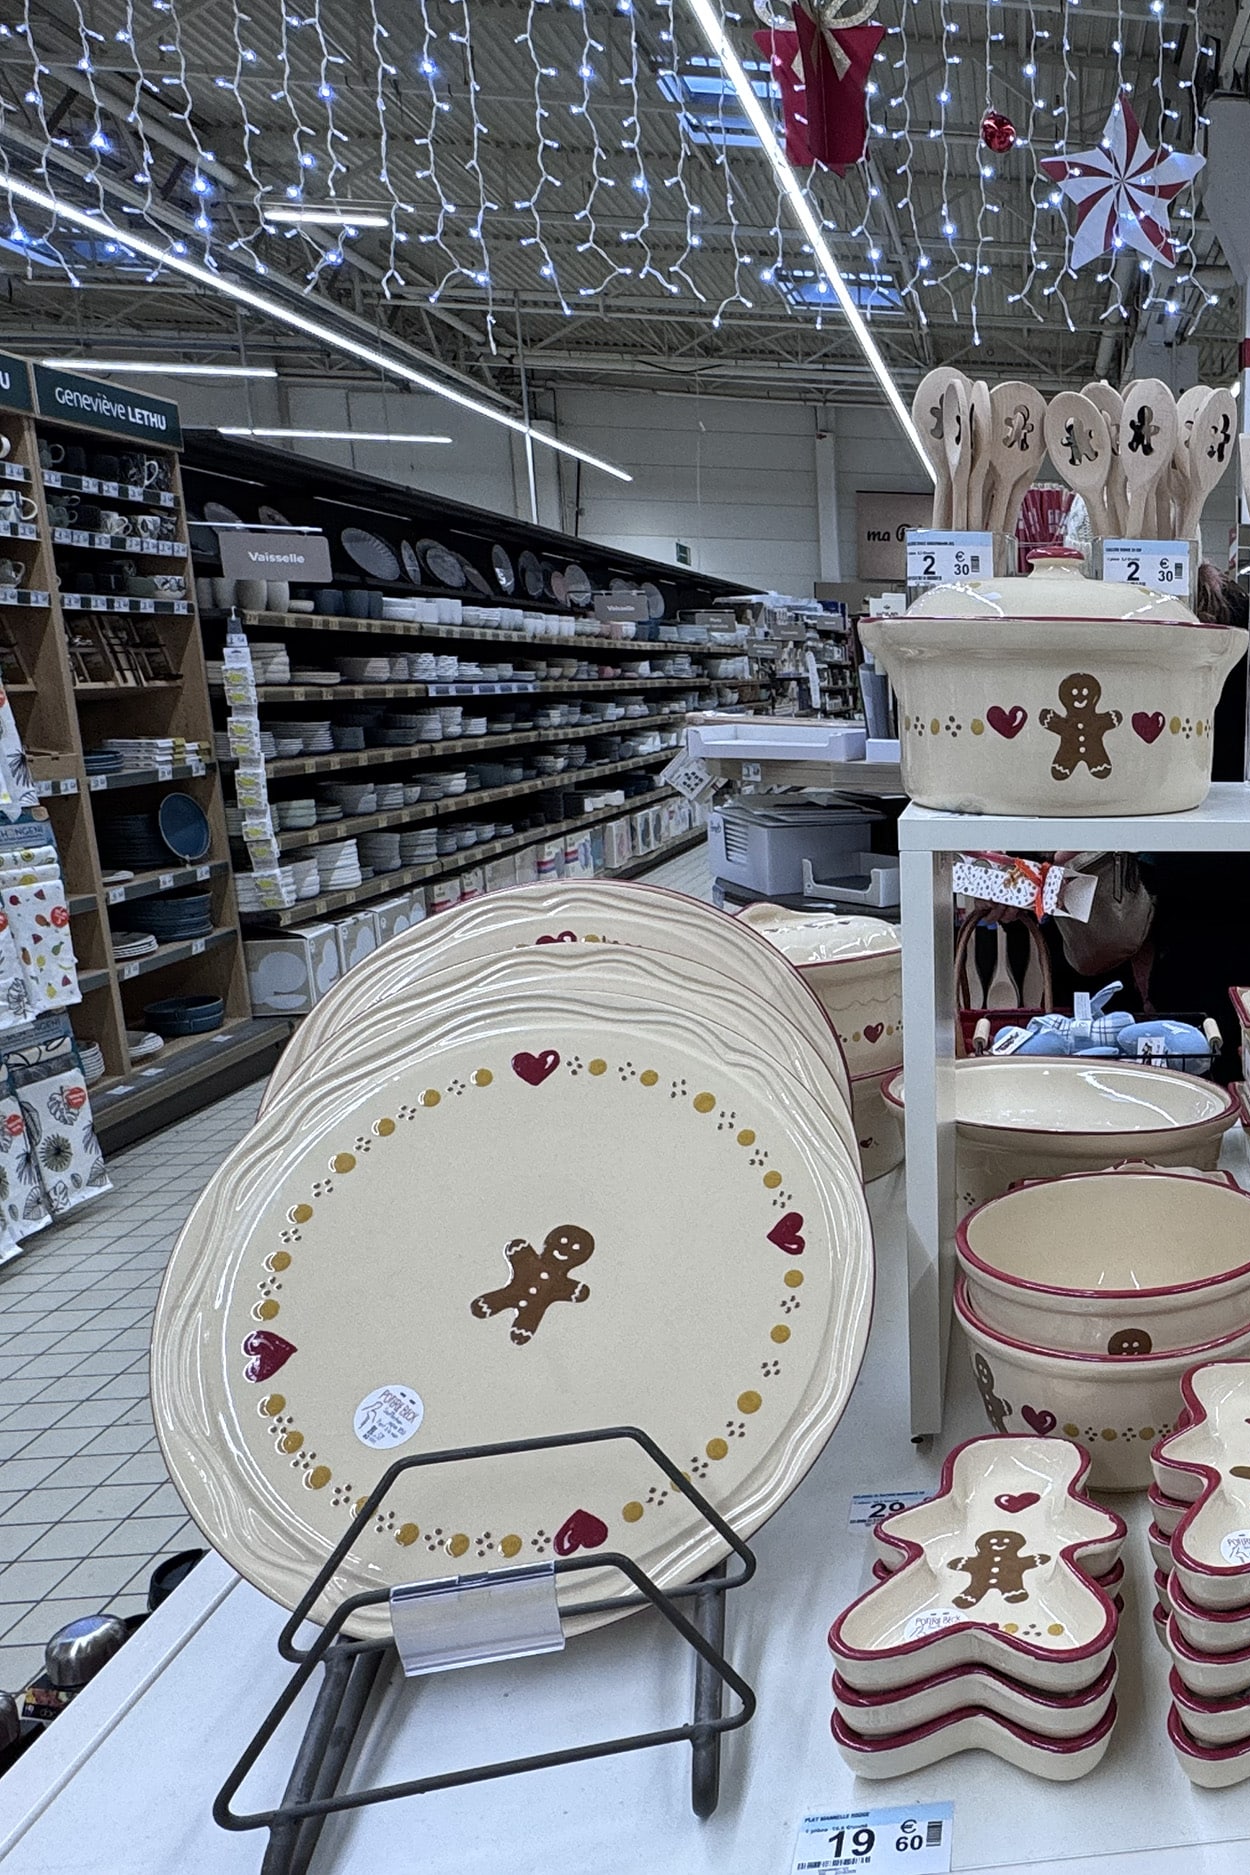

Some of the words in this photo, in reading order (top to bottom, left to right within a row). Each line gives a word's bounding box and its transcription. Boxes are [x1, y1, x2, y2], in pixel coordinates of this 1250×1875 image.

[55, 387, 126, 421] Geneviève
[128, 406, 167, 431] LETHU
[867, 530, 890, 542] ma
[248, 551, 305, 565] Vaisselle
[955, 551, 966, 562] €
[923, 555, 936, 575] 2
[954, 563, 970, 575] 30
[1159, 558, 1170, 570] €
[1127, 562, 1140, 581] 2
[1158, 570, 1173, 582] 30
[901, 1819, 918, 1834] €
[828, 1828, 876, 1858] 19
[895, 1835, 923, 1852] 60
